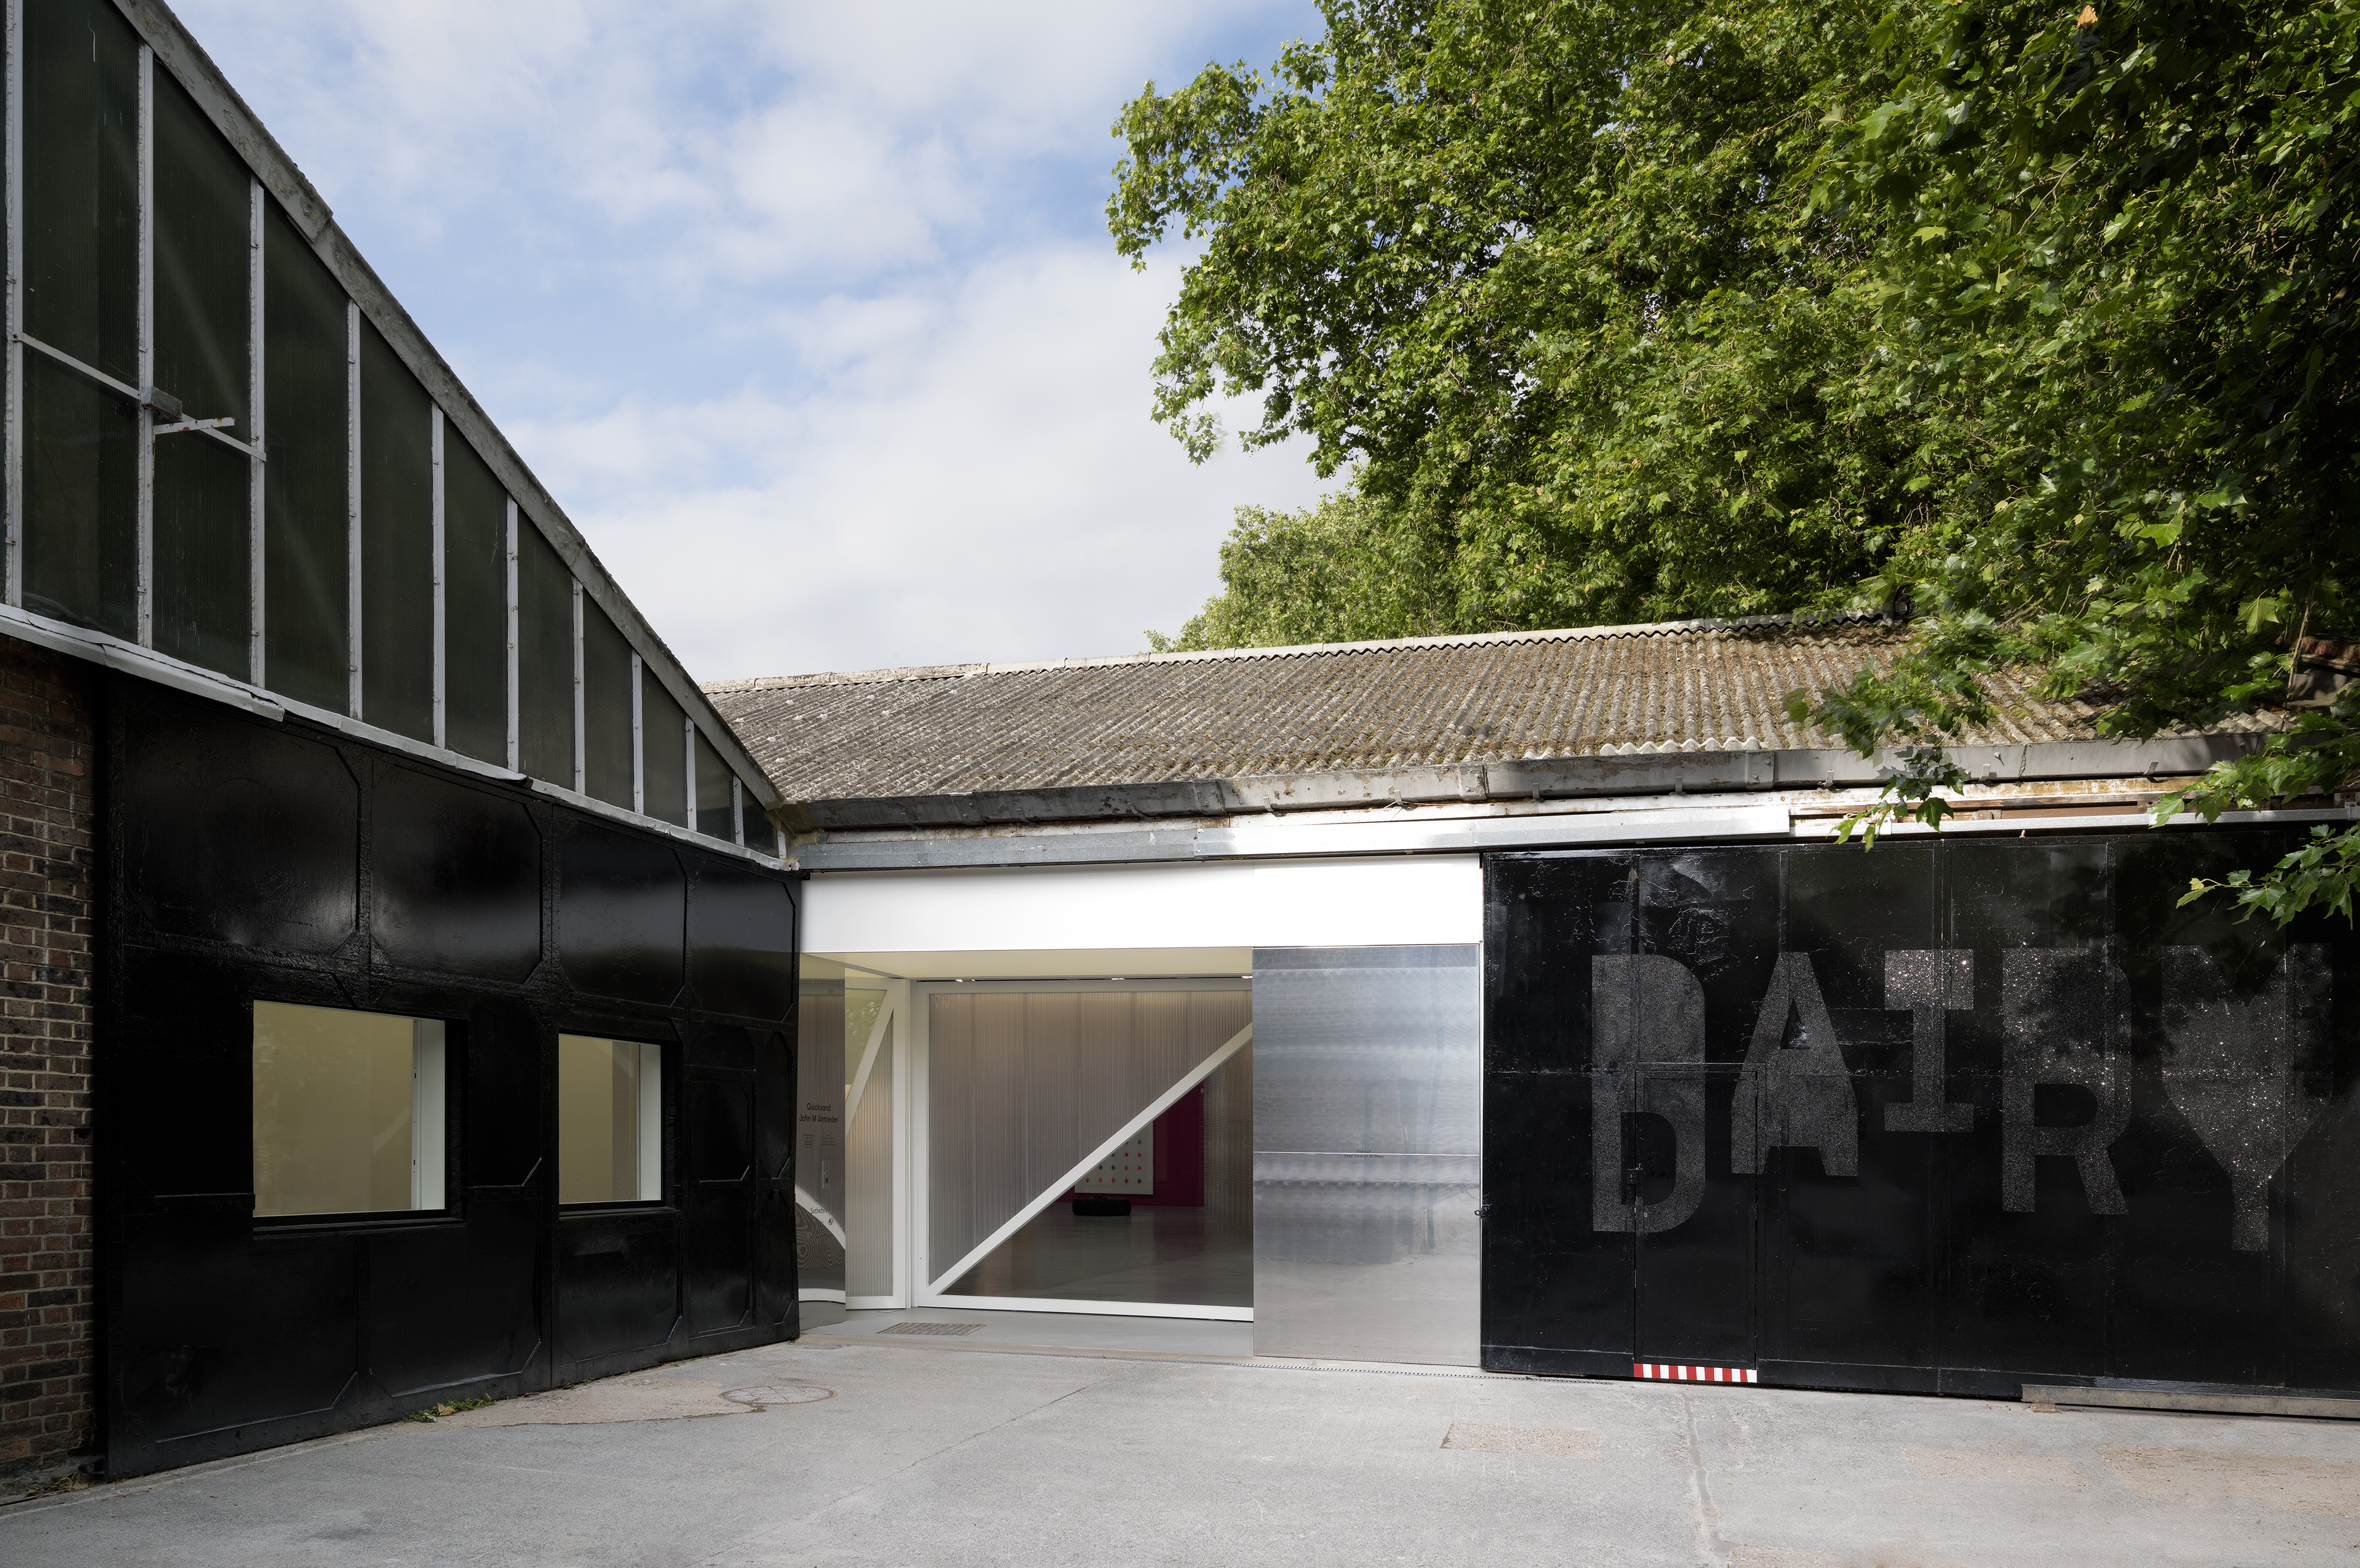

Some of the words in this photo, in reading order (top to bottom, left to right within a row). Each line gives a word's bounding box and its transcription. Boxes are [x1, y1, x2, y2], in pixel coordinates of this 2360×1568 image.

[1592, 944, 2332, 1251] DAIRY
[807, 1103, 831, 1111] Quicksand
[799, 1114, 811, 1122] John
[818, 1115, 838, 1123] Armleder
